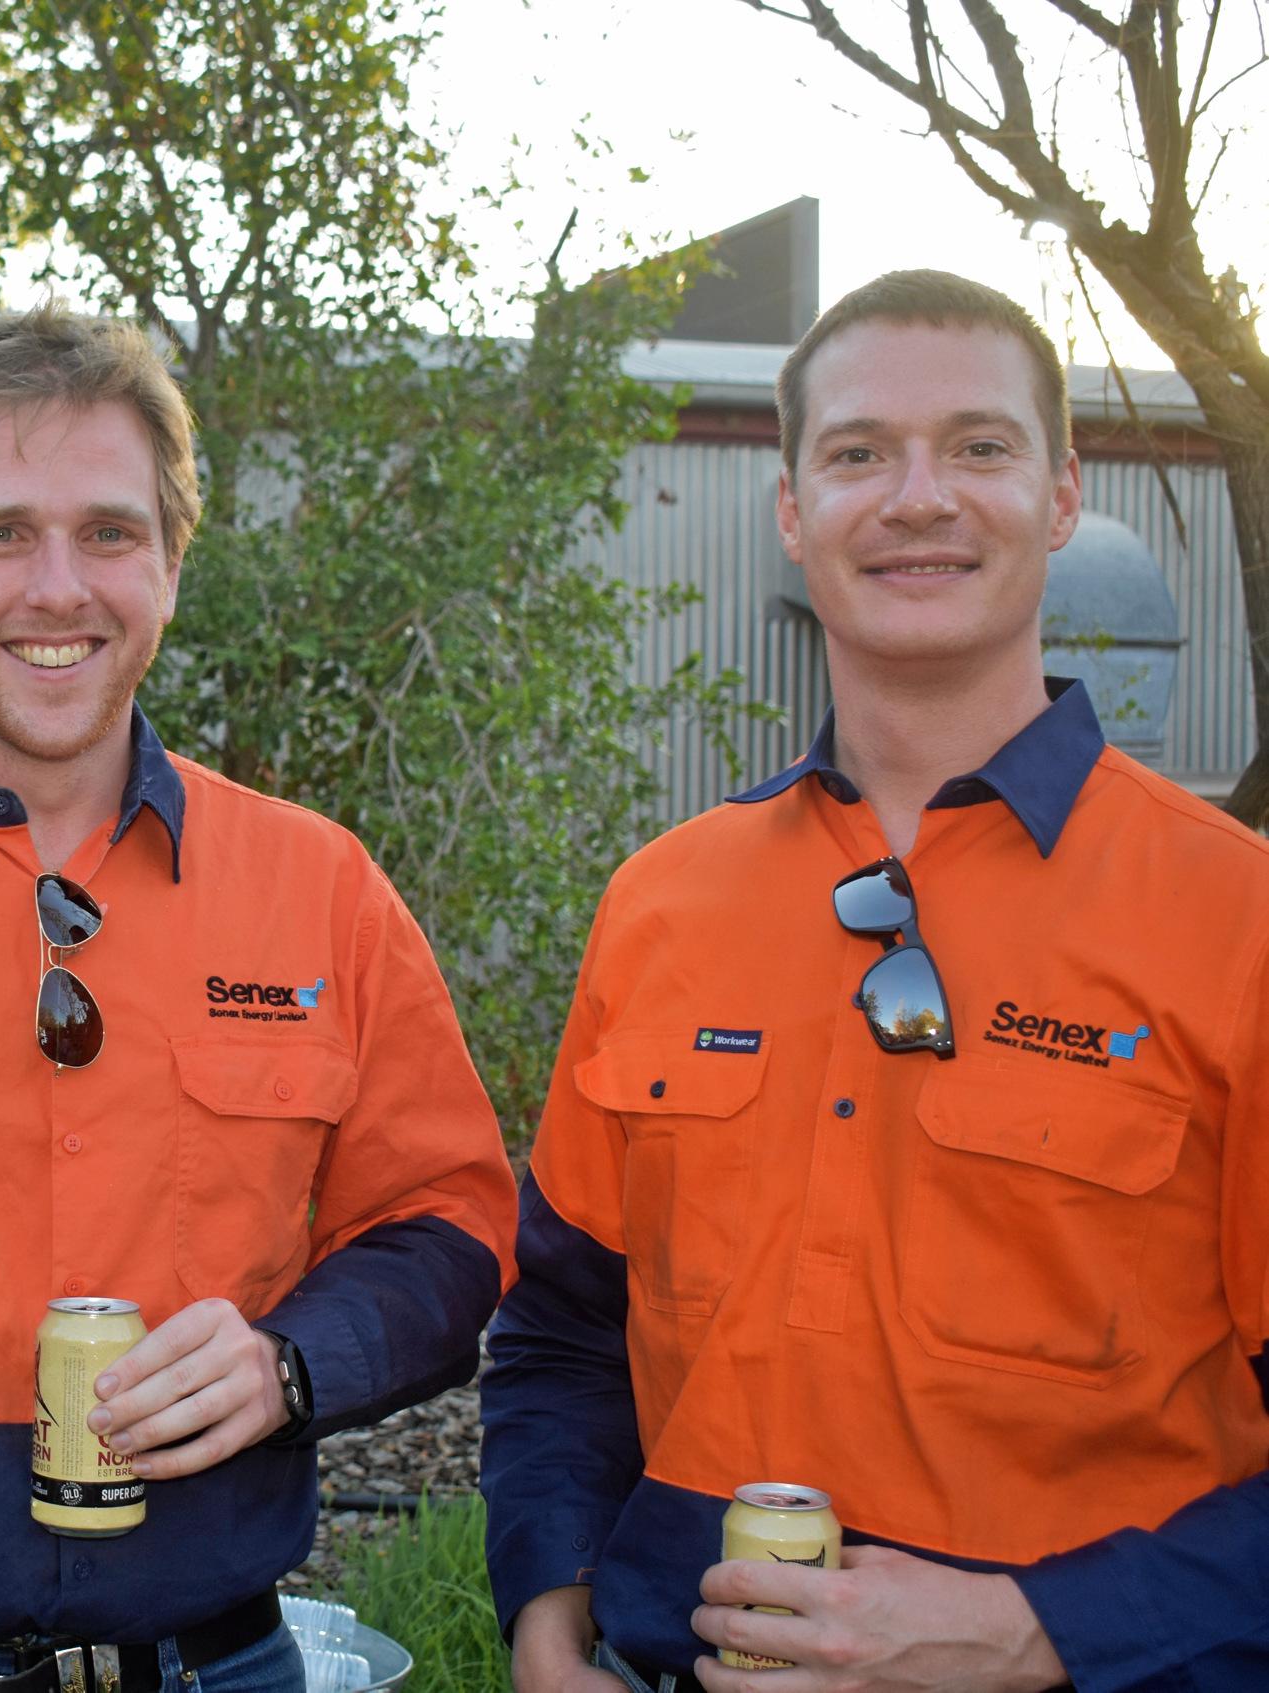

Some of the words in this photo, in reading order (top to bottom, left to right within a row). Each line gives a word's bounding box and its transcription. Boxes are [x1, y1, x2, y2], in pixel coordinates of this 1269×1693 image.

[205, 975, 298, 1007] Senex
[208, 1007, 239, 1019] Senex
[241, 1009, 273, 1022] Energy
[990, 1000, 1107, 1054] Senex
[714, 1035, 758, 1047] Workwear
[983, 1029, 1020, 1048] Senex
[1021, 1040, 1062, 1060] Energy
[1064, 1049, 1110, 1068] Limited
[101, 1487, 130, 1501] SUPER
